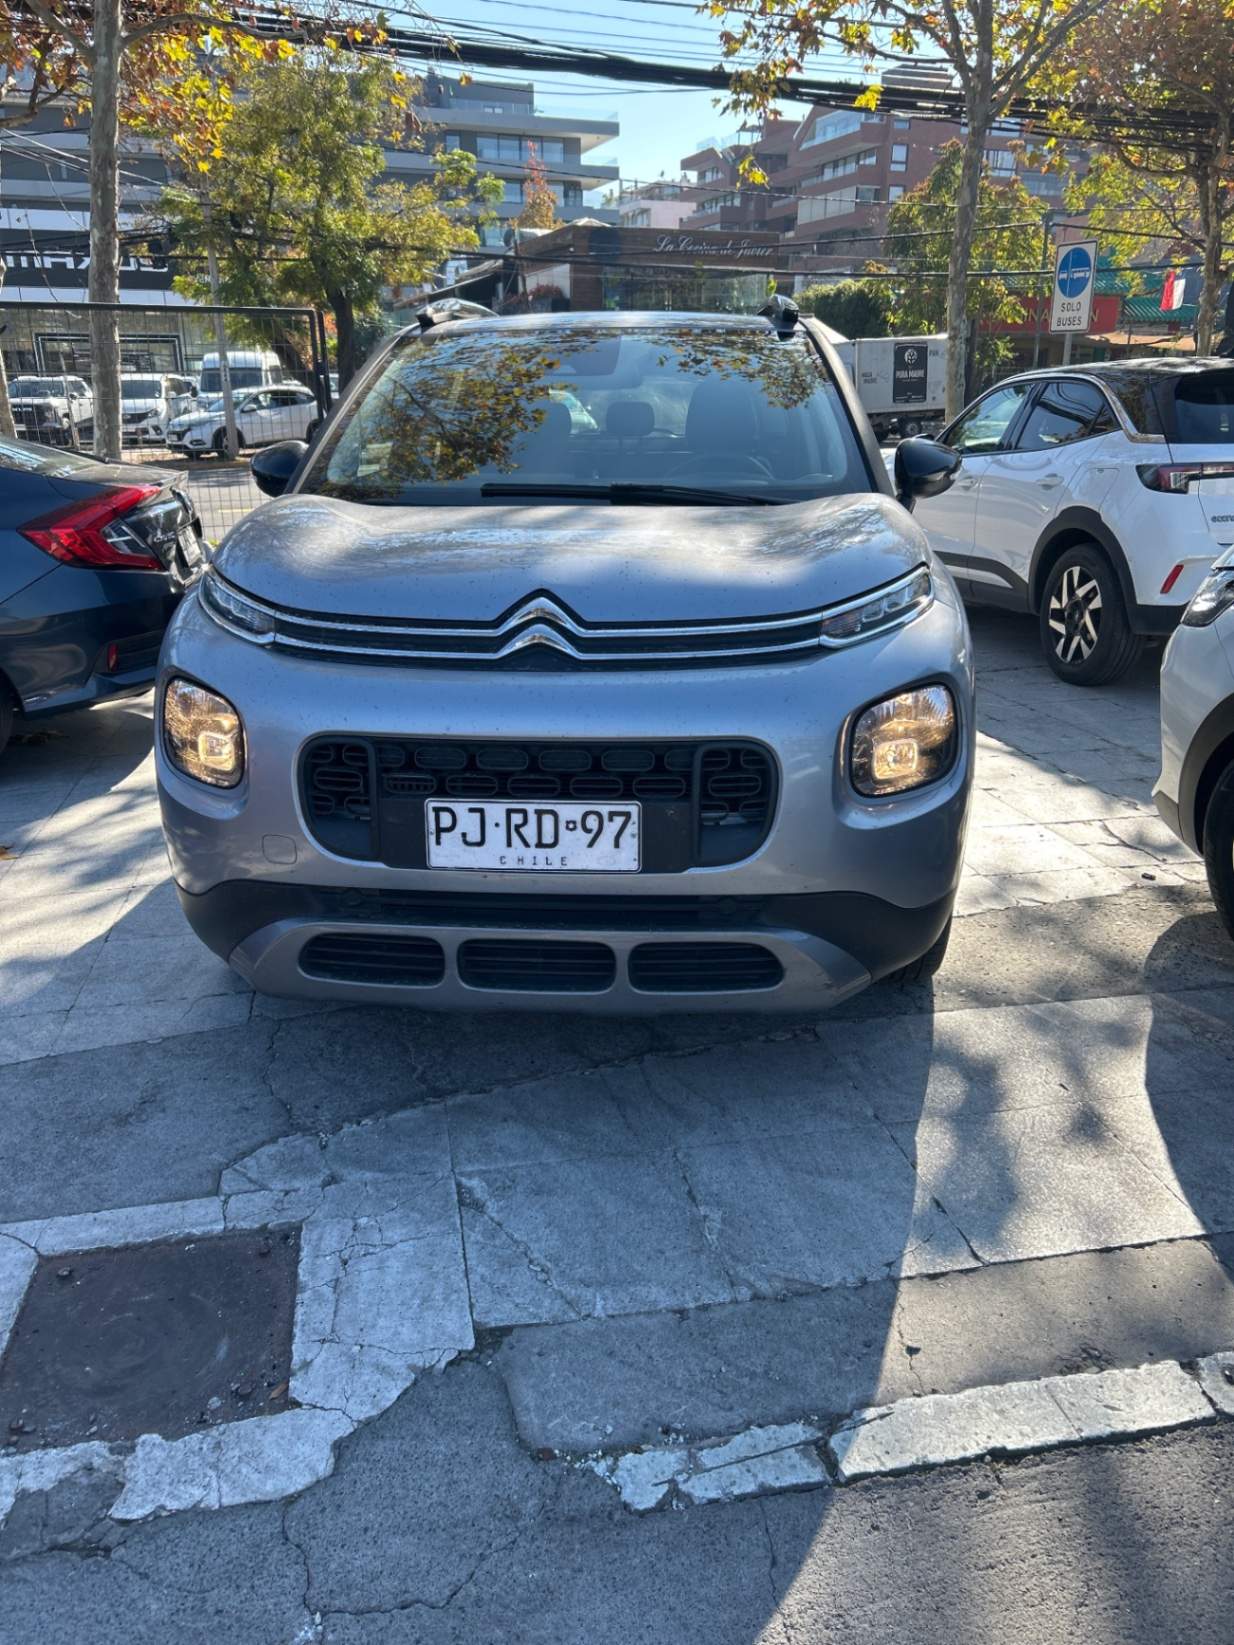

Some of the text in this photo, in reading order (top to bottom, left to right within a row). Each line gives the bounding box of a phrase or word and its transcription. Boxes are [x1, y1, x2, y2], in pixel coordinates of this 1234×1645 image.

[1060, 301, 1082, 313] SOLO
[1056, 315, 1082, 327] BUSES
[499, 855, 568, 867] CHILE
